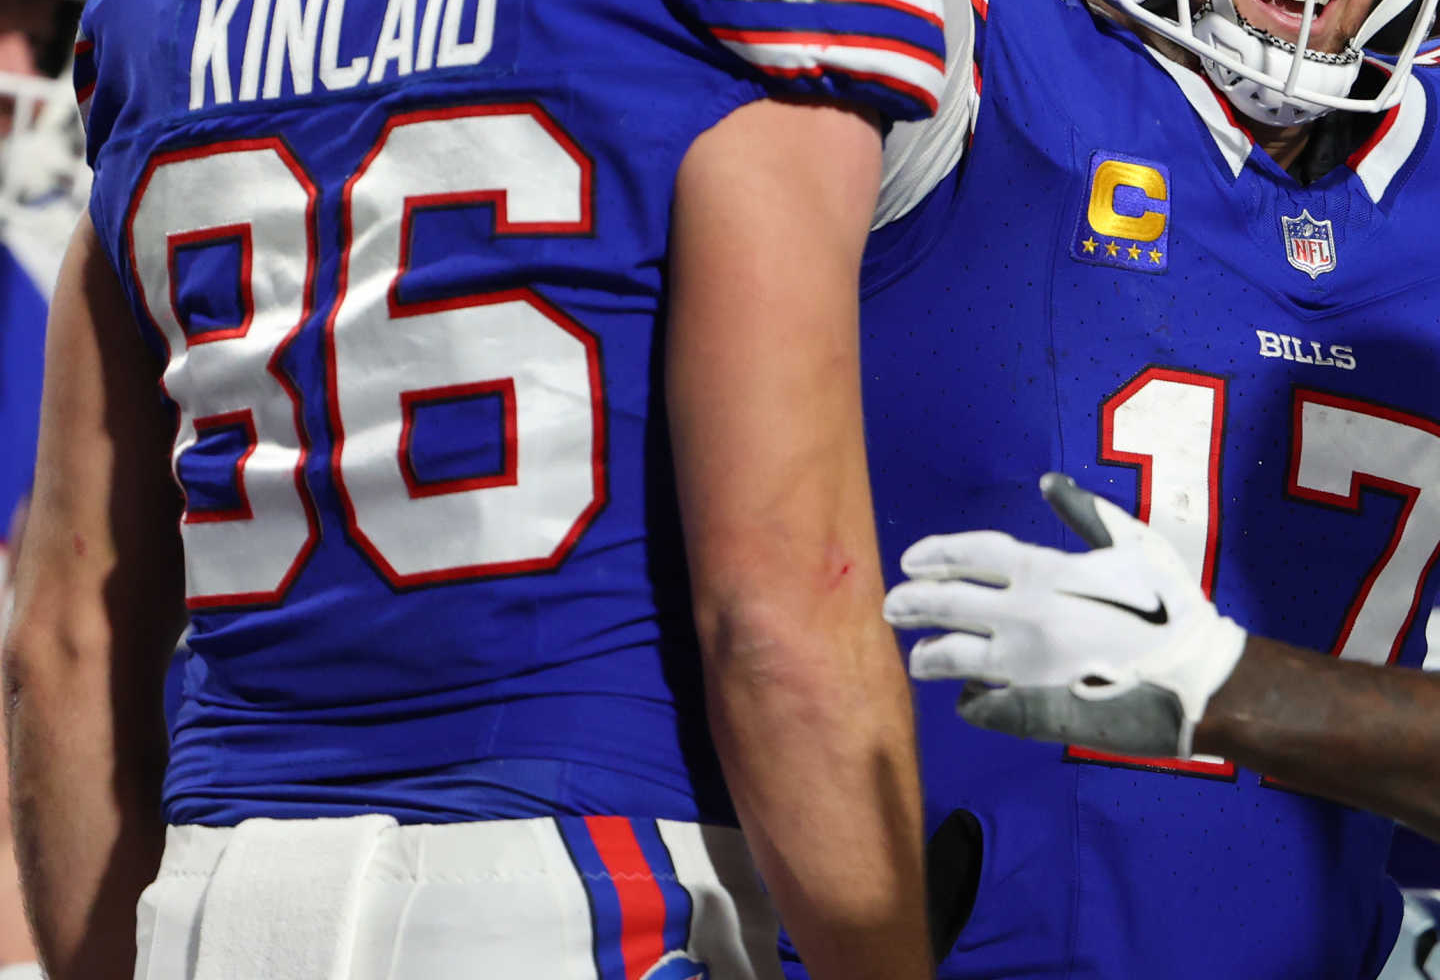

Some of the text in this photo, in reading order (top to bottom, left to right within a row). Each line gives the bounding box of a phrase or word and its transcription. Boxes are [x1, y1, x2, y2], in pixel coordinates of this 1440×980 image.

[1087, 160, 1168, 243] C
[1294, 239, 1329, 266] NFL
[125, 100, 610, 611] 86
[1256, 329, 1357, 371] BILLS
